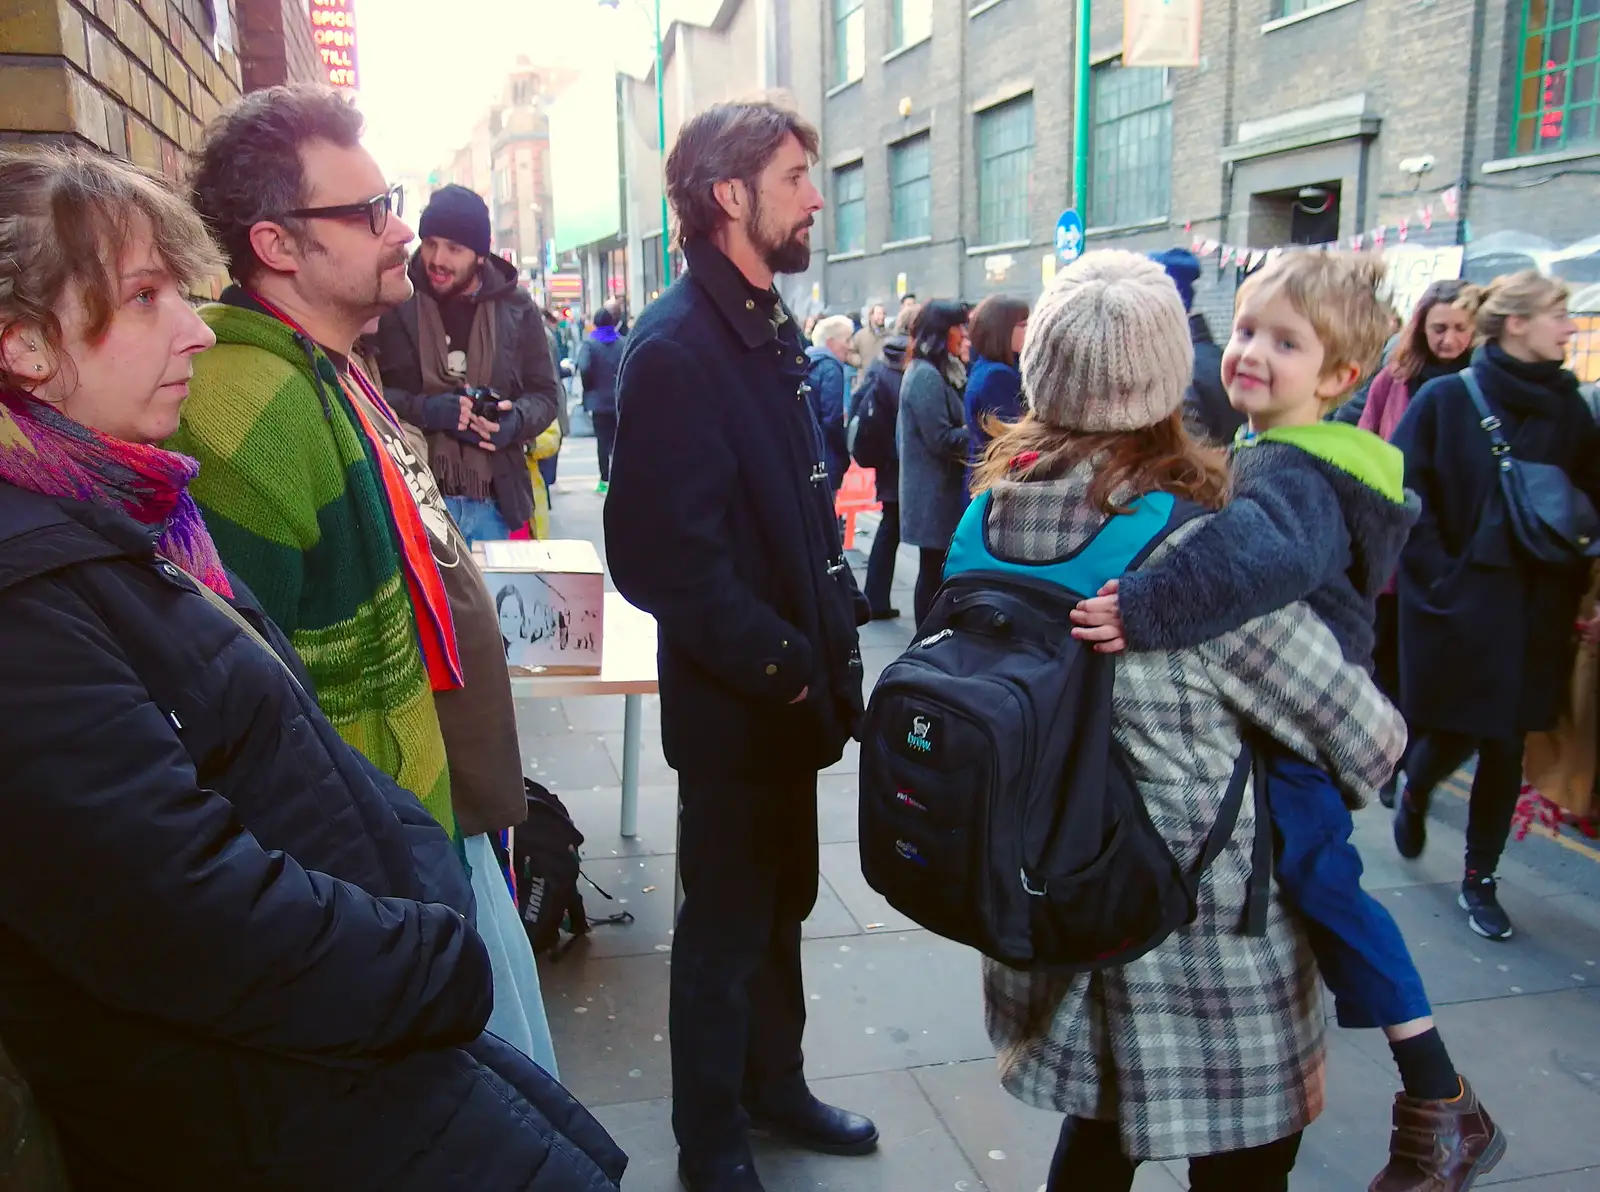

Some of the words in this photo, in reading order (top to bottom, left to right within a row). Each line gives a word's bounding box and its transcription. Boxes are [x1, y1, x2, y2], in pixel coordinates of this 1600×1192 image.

[312, 10, 353, 28] SPICE
[314, 29, 354, 47] OPEN
[320, 48, 352, 67] TILL
[329, 69, 355, 86] ATE
[524, 876, 545, 922] THULE
